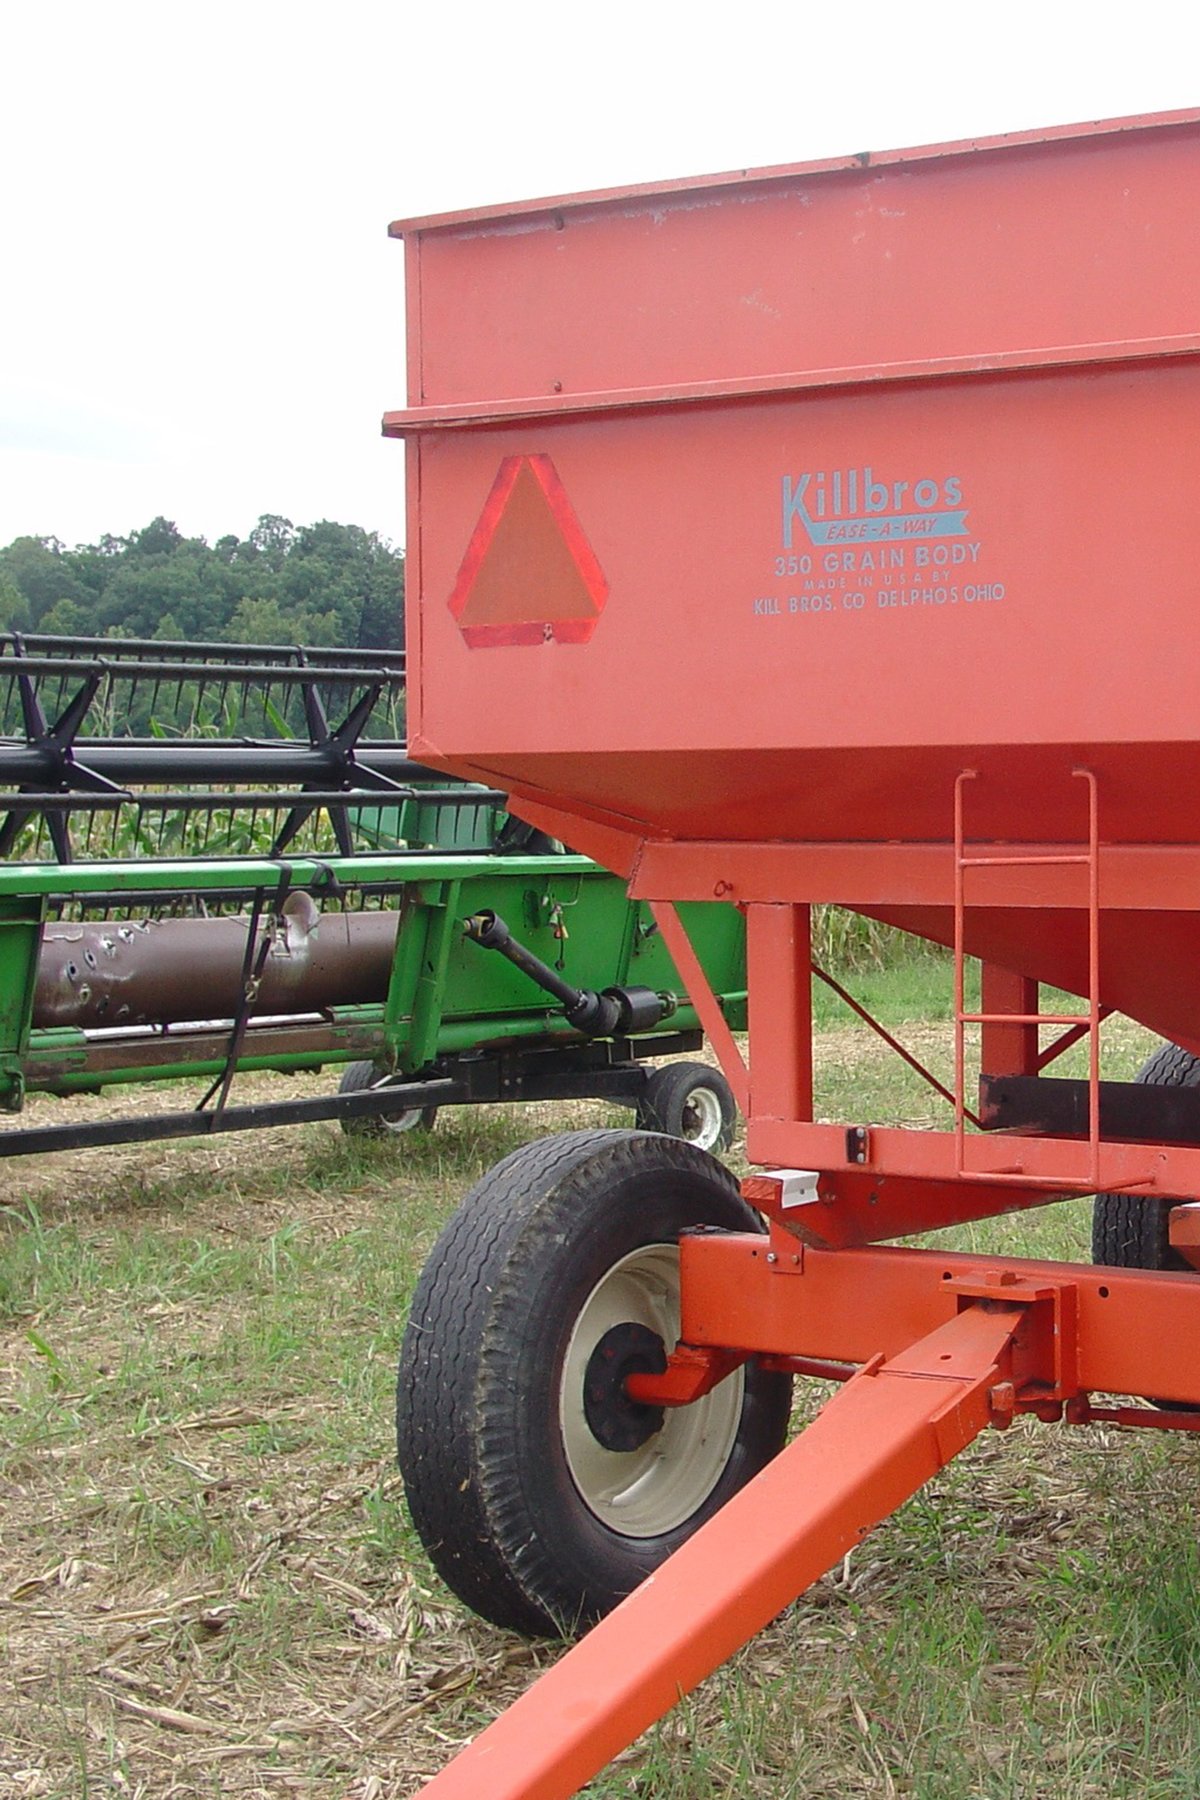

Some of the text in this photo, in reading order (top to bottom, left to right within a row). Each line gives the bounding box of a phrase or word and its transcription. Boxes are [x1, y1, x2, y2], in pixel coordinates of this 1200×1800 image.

[781, 467, 963, 549] Killbros
[826, 518, 938, 540] EASE-A-WAY
[774, 542, 981, 577] 350 GRAIN BODY
[804, 577, 846, 590] MADE
[858, 576, 873, 587] IN
[932, 570, 950, 582] BY
[753, 583, 1006, 616] KILL BROS. CO DELPHOS OHIO
